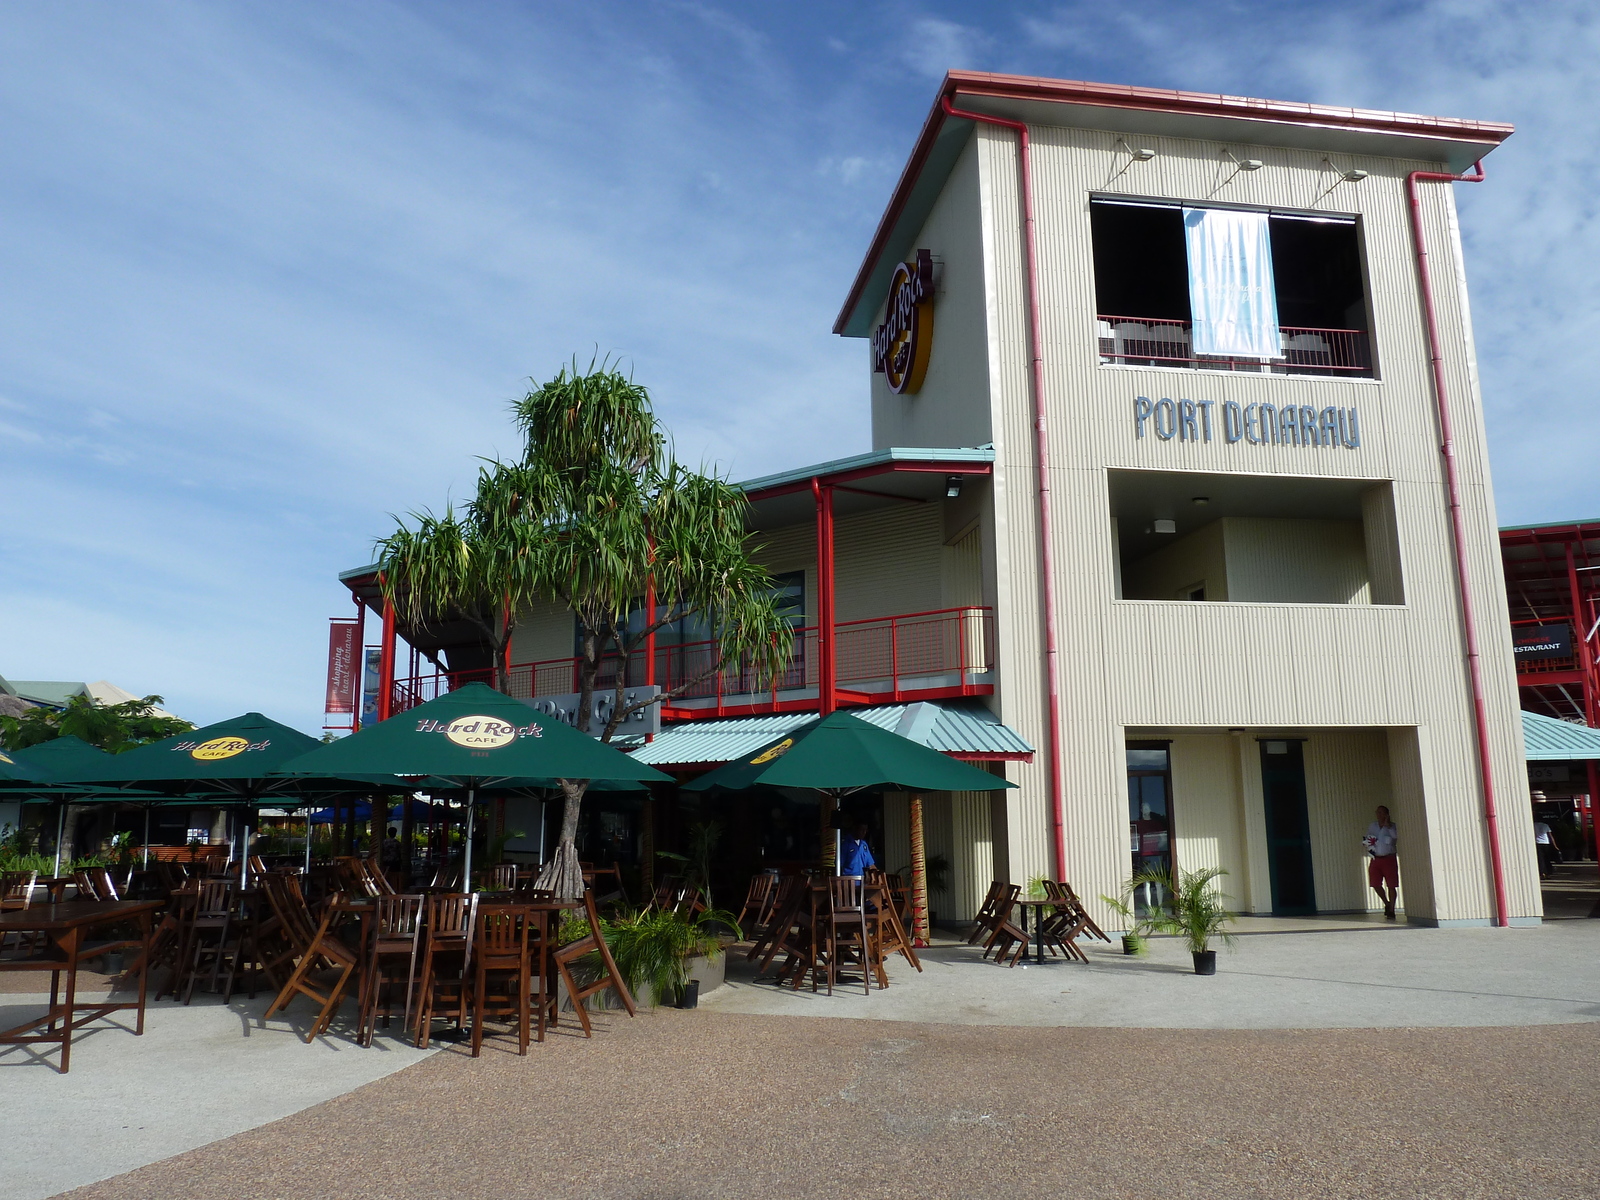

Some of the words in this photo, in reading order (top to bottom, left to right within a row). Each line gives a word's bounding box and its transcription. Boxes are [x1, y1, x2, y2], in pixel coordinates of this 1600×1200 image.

[873, 294, 898, 372] Hard
[898, 249, 923, 331] Rock
[1136, 396, 1214, 441] PORT
[1225, 400, 1360, 447] DENARAU
[342, 627, 352, 664] denarau
[1513, 643, 1561, 653] ESTAURANT
[1516, 636, 1550, 645] CHINESE
[331, 647, 344, 687] shopping
[340, 669, 350, 695] heart
[416, 719, 481, 734] Hard
[484, 722, 543, 738] Rock
[171, 741, 226, 751] Hard
[223, 740, 271, 751] Rock
